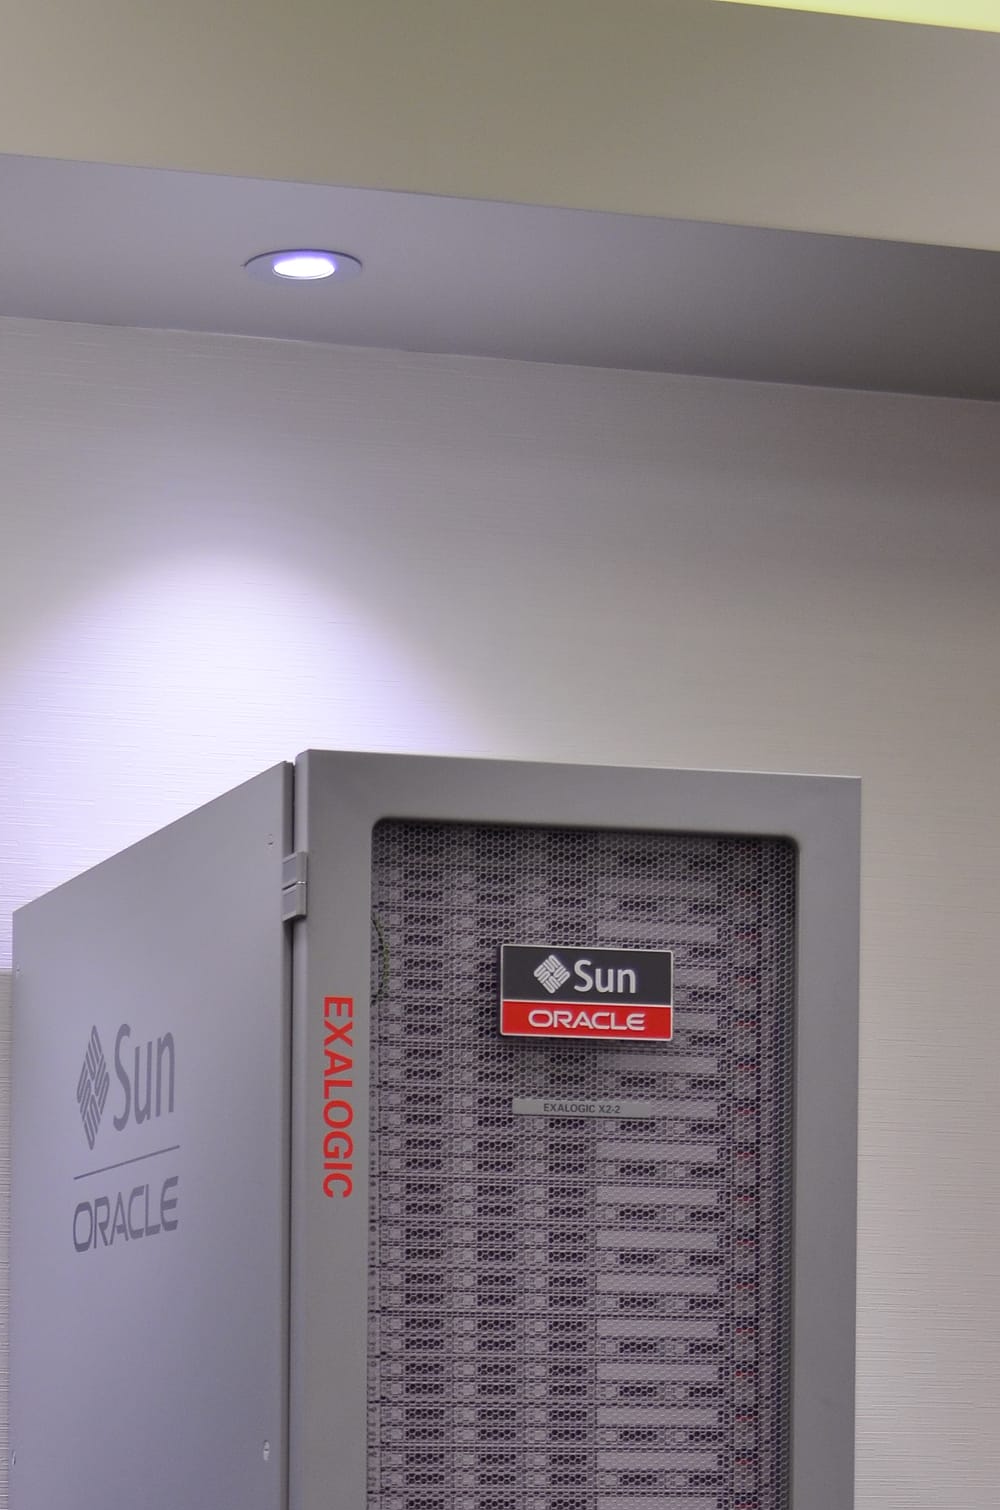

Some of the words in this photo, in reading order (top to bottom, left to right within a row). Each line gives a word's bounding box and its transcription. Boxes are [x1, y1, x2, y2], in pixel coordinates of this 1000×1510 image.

[573, 959, 637, 994] Sun
[528, 1009, 646, 1031] ORACLE
[113, 1023, 176, 1132] Sun
[321, 994, 355, 1199] EXALOGIC
[543, 1103, 596, 1113] EXALOGIC
[598, 1104, 621, 1114] X2-2
[73, 1175, 179, 1253] ORACLE
